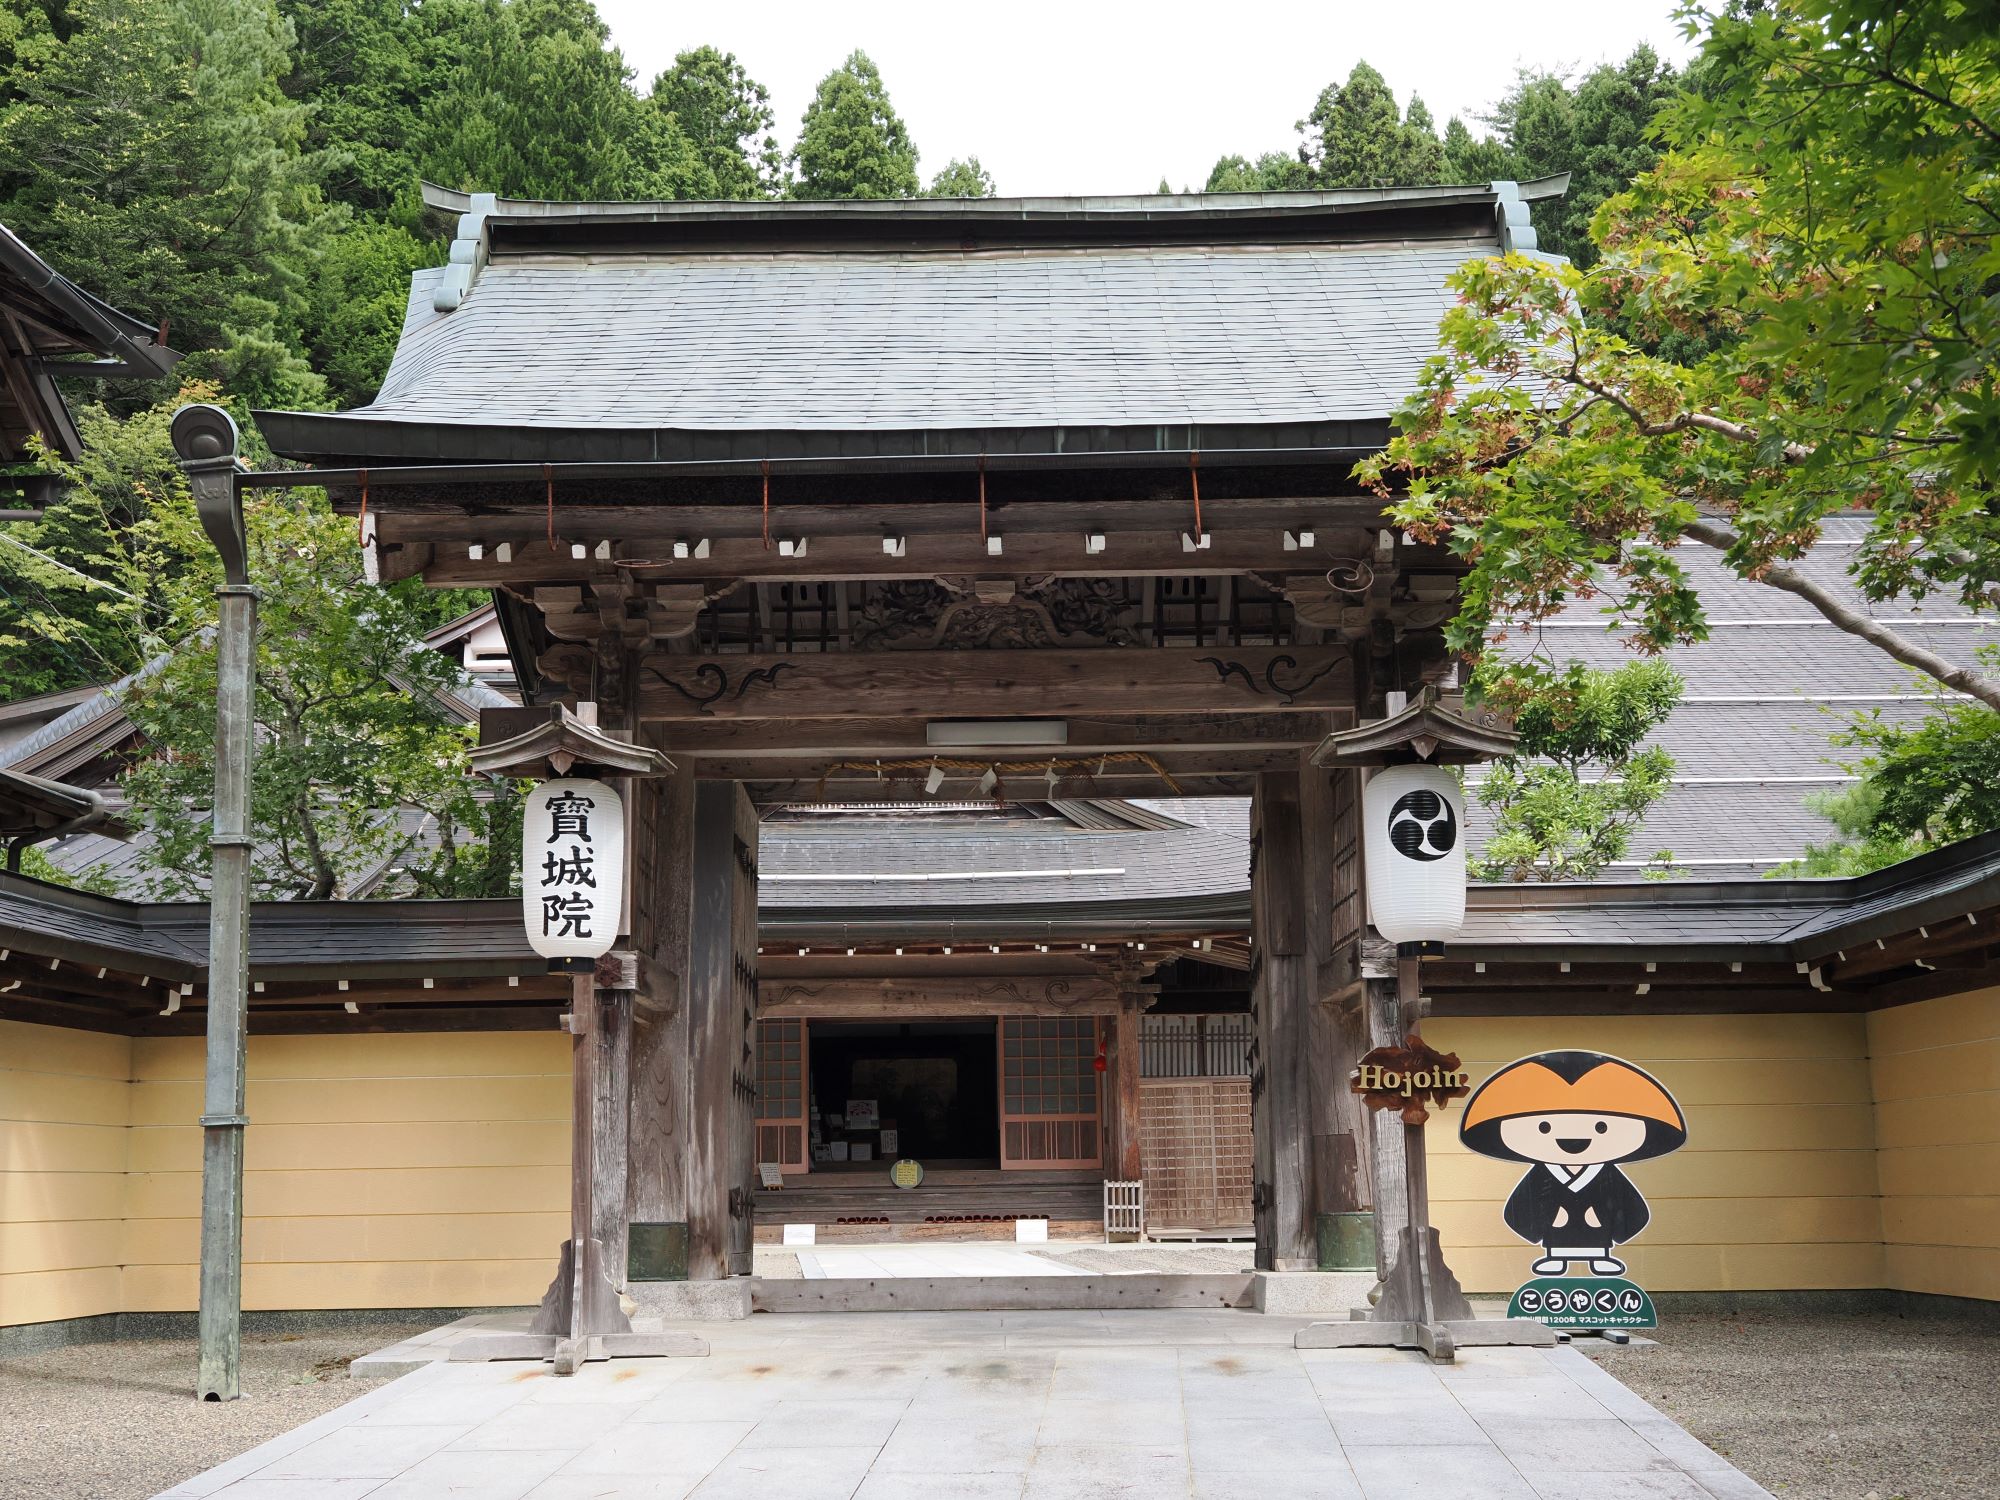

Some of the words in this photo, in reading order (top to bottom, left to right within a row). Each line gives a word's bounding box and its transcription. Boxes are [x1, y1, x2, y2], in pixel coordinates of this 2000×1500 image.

[1358, 1065, 1465, 1097] Hojoin
[1523, 1293, 1639, 1309] こうやくん
[1579, 1316, 1649, 1324] マスコットキャラクター
